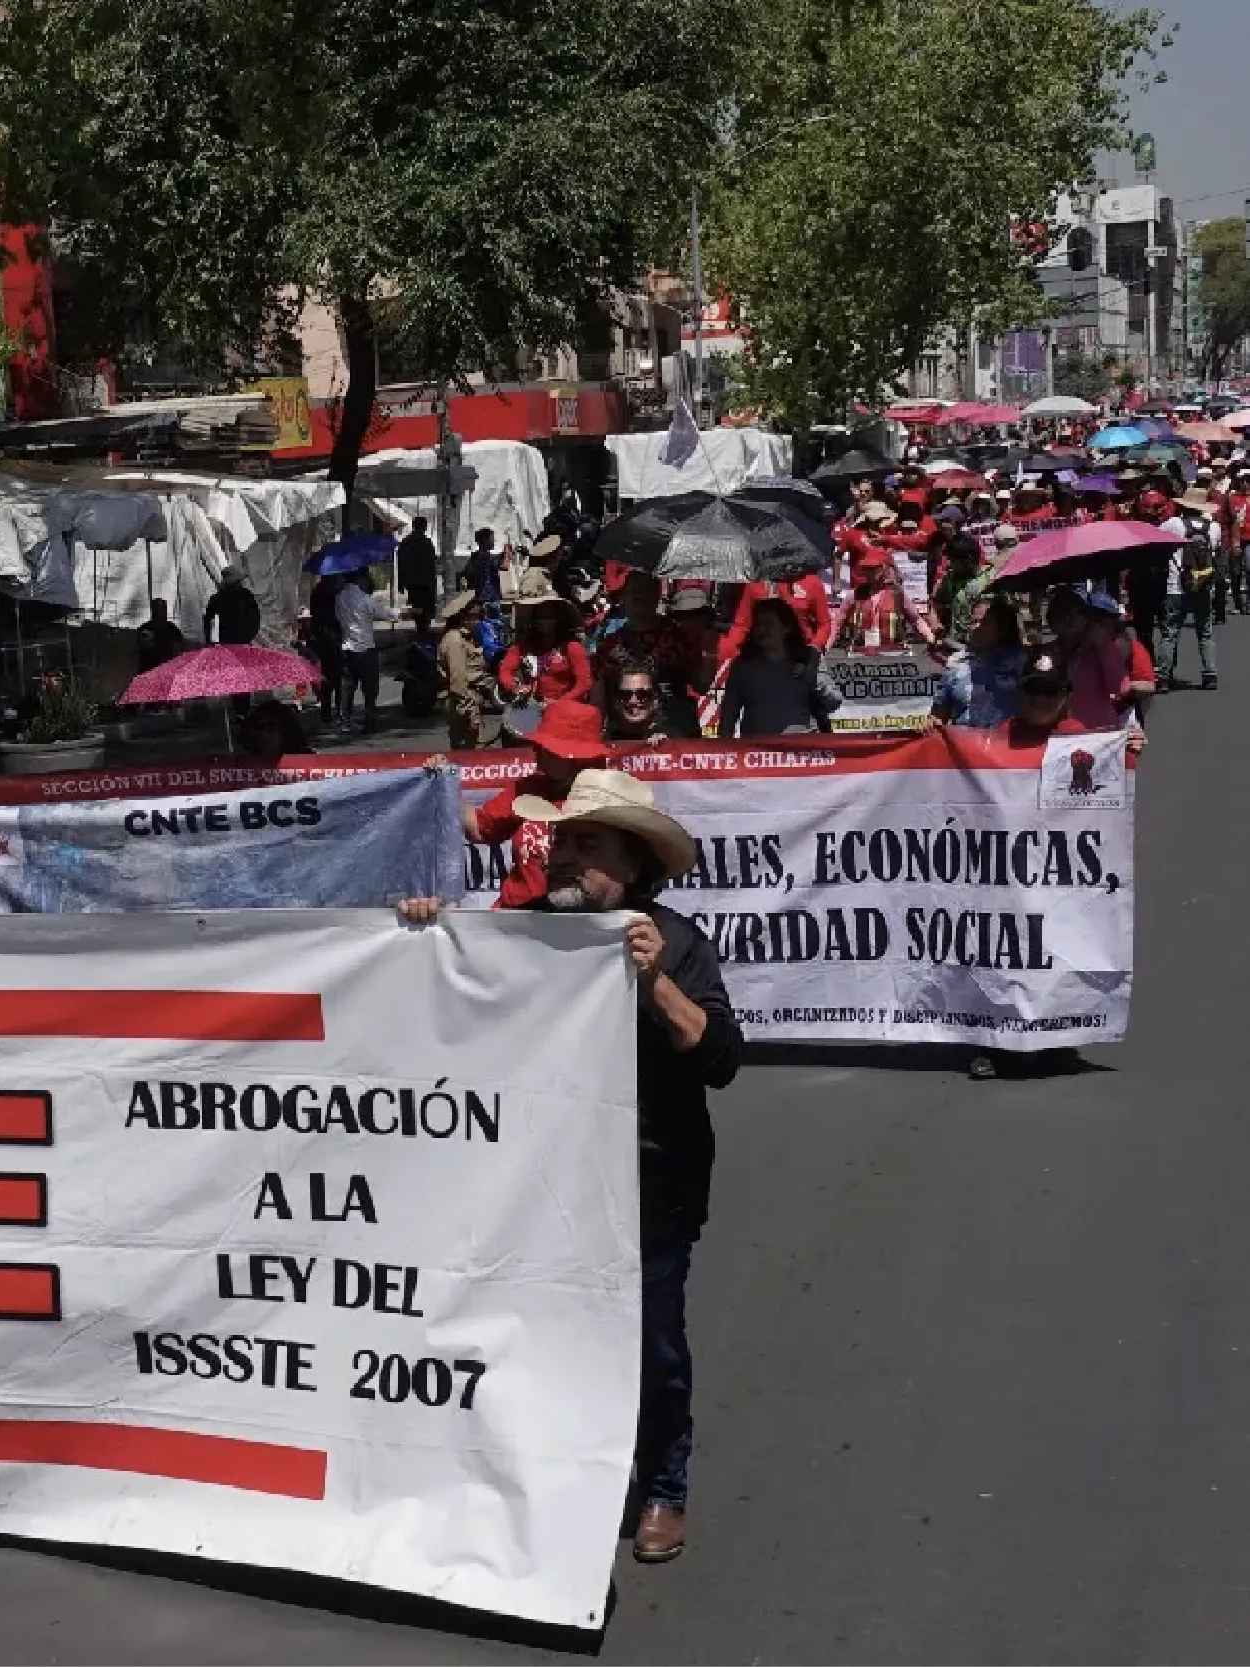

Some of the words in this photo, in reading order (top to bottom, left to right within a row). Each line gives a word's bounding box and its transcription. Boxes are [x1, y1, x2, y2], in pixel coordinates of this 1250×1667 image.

[42, 774, 129, 795] SECCIÓN
[168, 769, 205, 787] DEL
[461, 758, 538, 780] ECCIÓN
[622, 750, 738, 772] SNTE-CNTE
[124, 803, 229, 836] CNTE
[239, 797, 323, 831] BCS
[667, 833, 794, 894] ALES,
[812, 817, 1120, 894] ECONÓMICAS,
[692, 906, 890, 966] URIDAD
[906, 908, 1053, 970] SOCIAL
[125, 1077, 500, 1142] ABROGACIÓN
[254, 1172, 292, 1219] A
[309, 1172, 378, 1223] LA
[217, 1253, 316, 1303] LEY
[333, 1257, 424, 1317] DEL
[133, 1331, 317, 1392] ISSSTE
[350, 1349, 486, 1409] 2007
